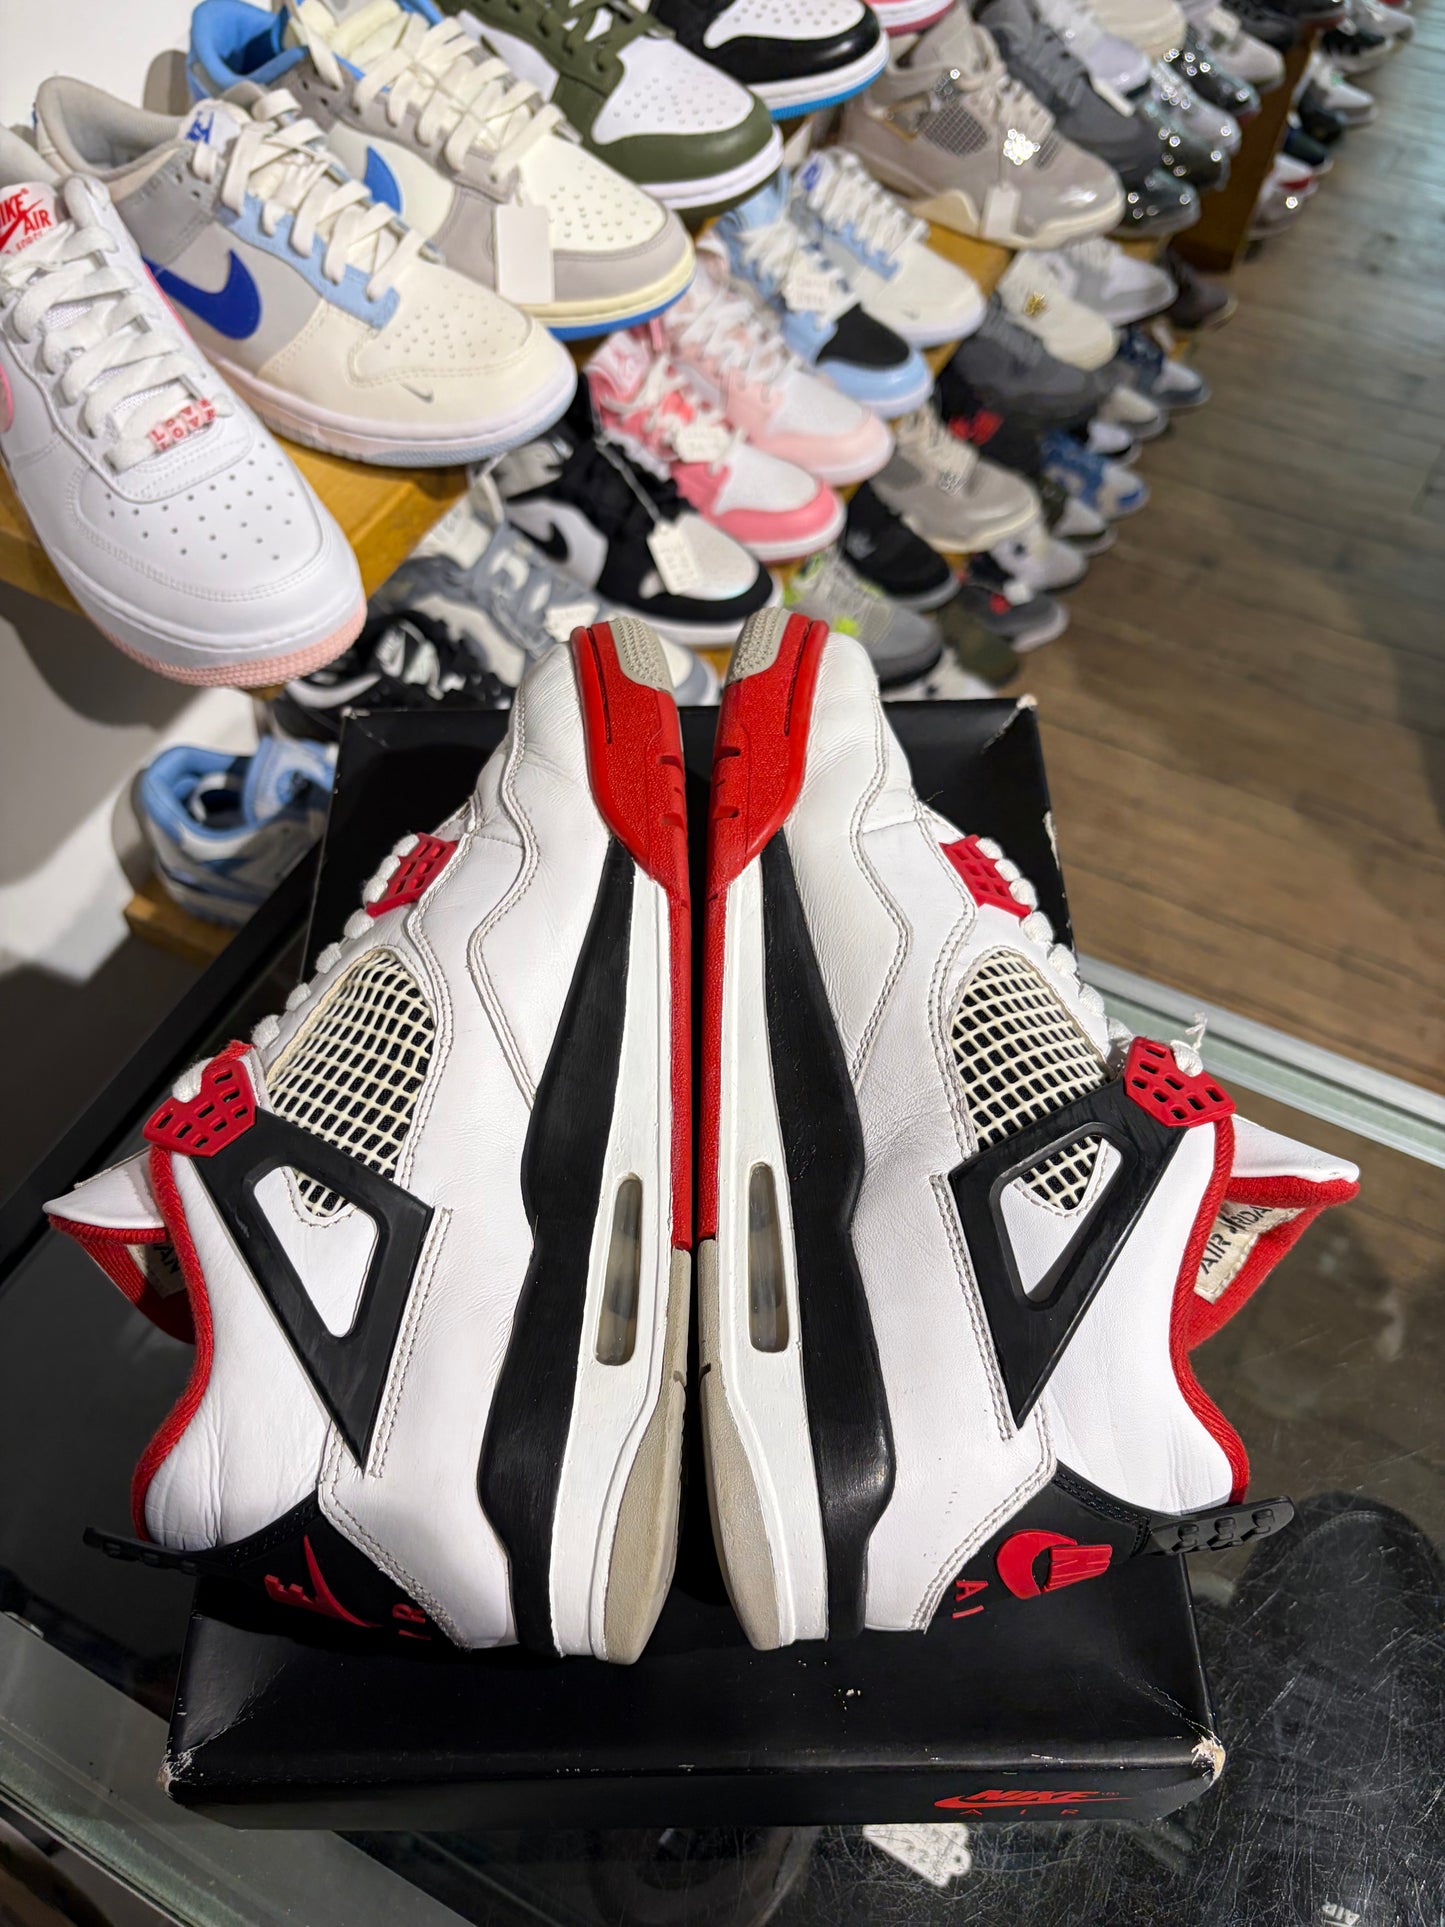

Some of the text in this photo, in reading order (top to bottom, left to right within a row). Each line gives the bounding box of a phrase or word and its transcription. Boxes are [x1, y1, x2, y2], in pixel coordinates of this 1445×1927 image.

[0, 194, 23, 226] IKE
[24, 209, 52, 235] AIR
[1200, 1233, 1232, 1275] AIR
[964, 1789, 1100, 1801] NIKE
